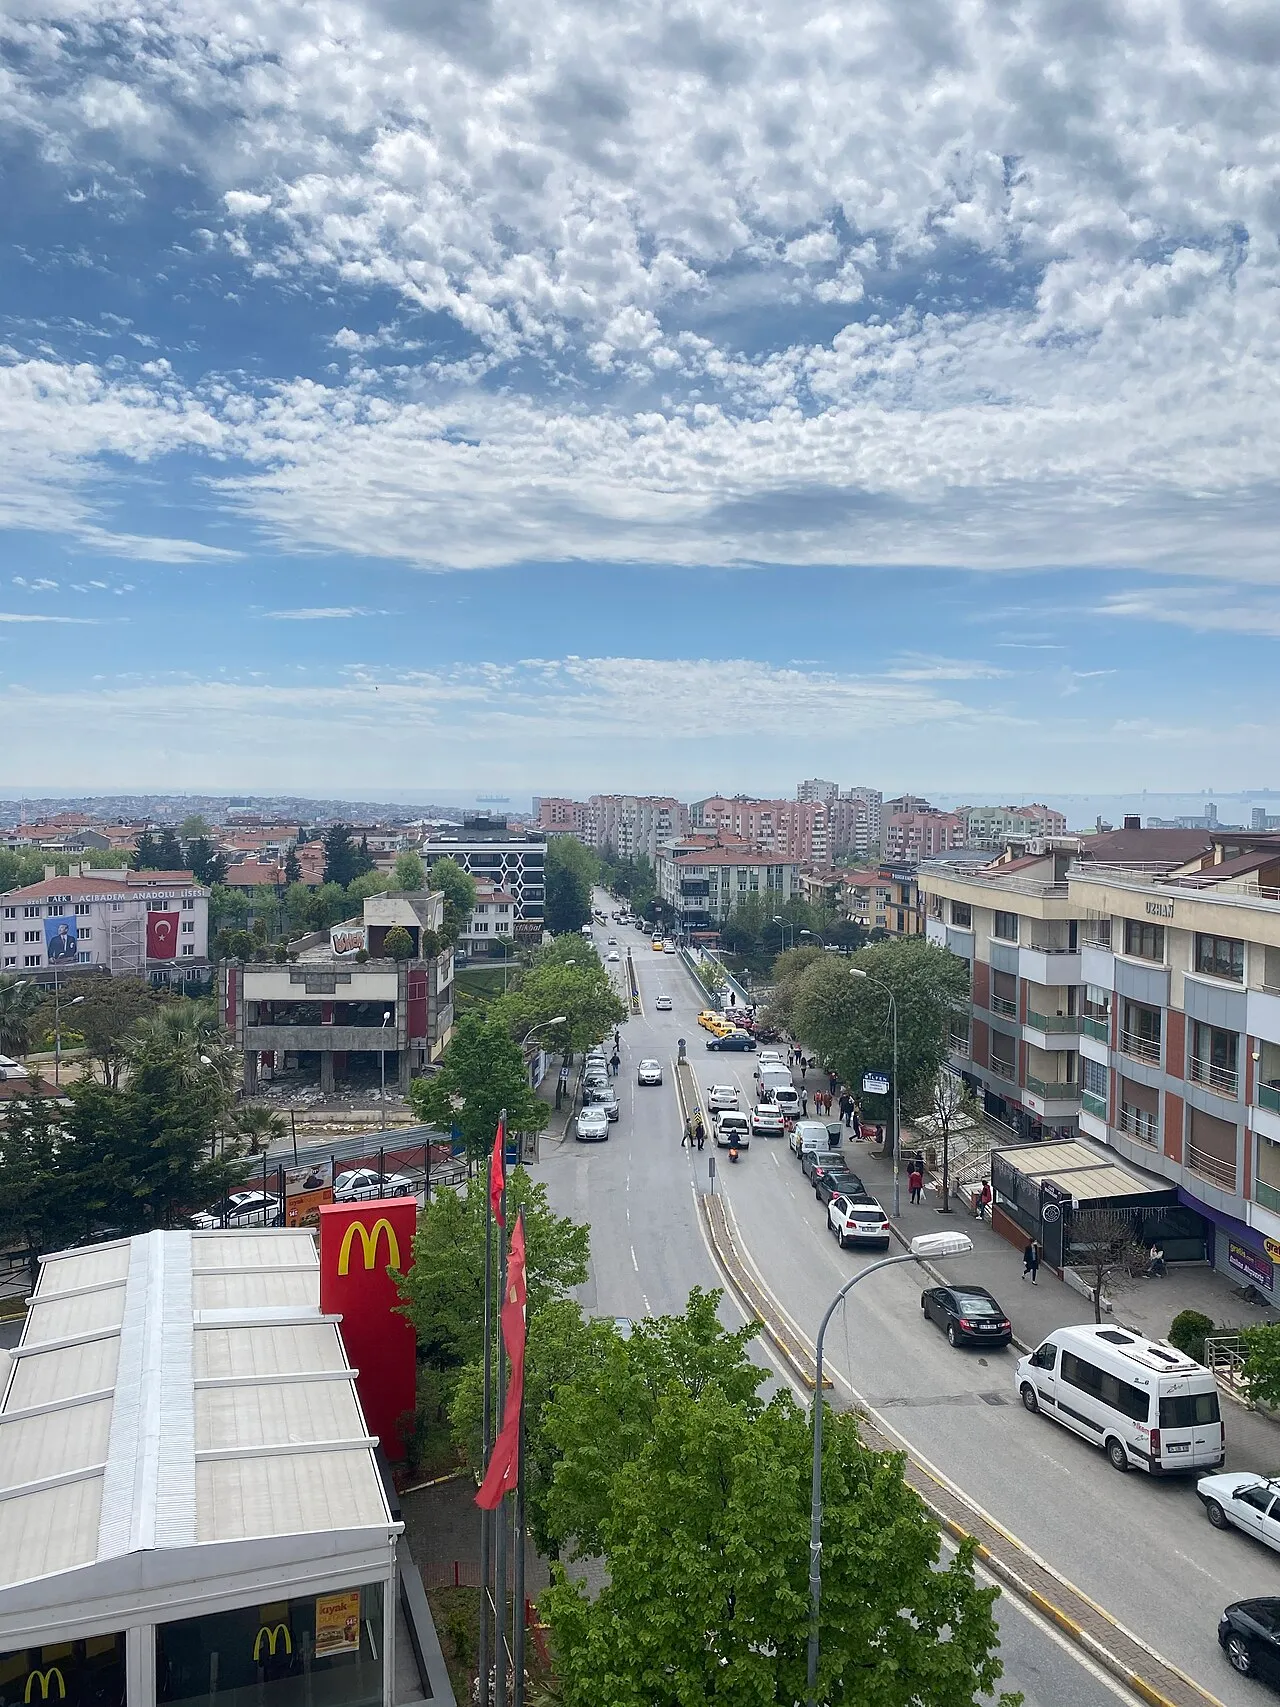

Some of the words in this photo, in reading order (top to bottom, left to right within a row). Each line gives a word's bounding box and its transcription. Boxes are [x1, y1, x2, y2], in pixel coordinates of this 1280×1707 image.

[79, 893, 125, 902] ACIBADEM
[132, 891, 175, 900] ANADOLU
[1145, 901, 1174, 918] UZHAN
